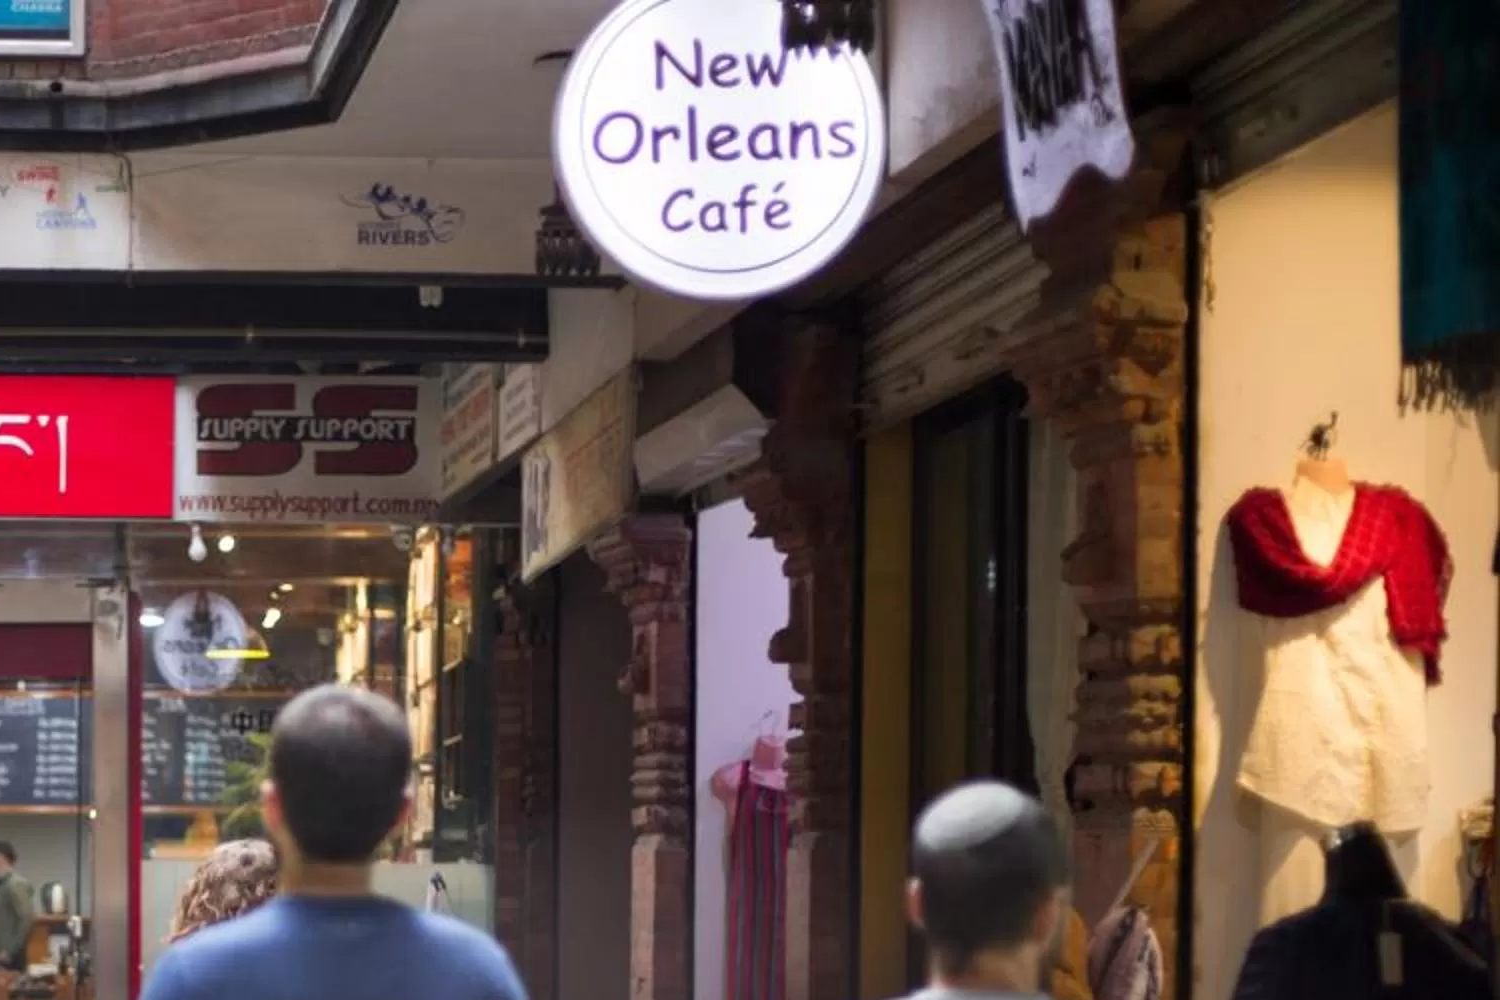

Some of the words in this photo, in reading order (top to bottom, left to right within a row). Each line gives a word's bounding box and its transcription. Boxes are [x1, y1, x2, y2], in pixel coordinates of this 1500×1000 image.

[654, 37, 788, 91] New
[593, 105, 856, 164] Orleans
[661, 181, 791, 234] Café
[357, 229, 431, 245] RIVERS
[199, 418, 287, 440] SUPPLY
[293, 418, 412, 440] SUPPORT
